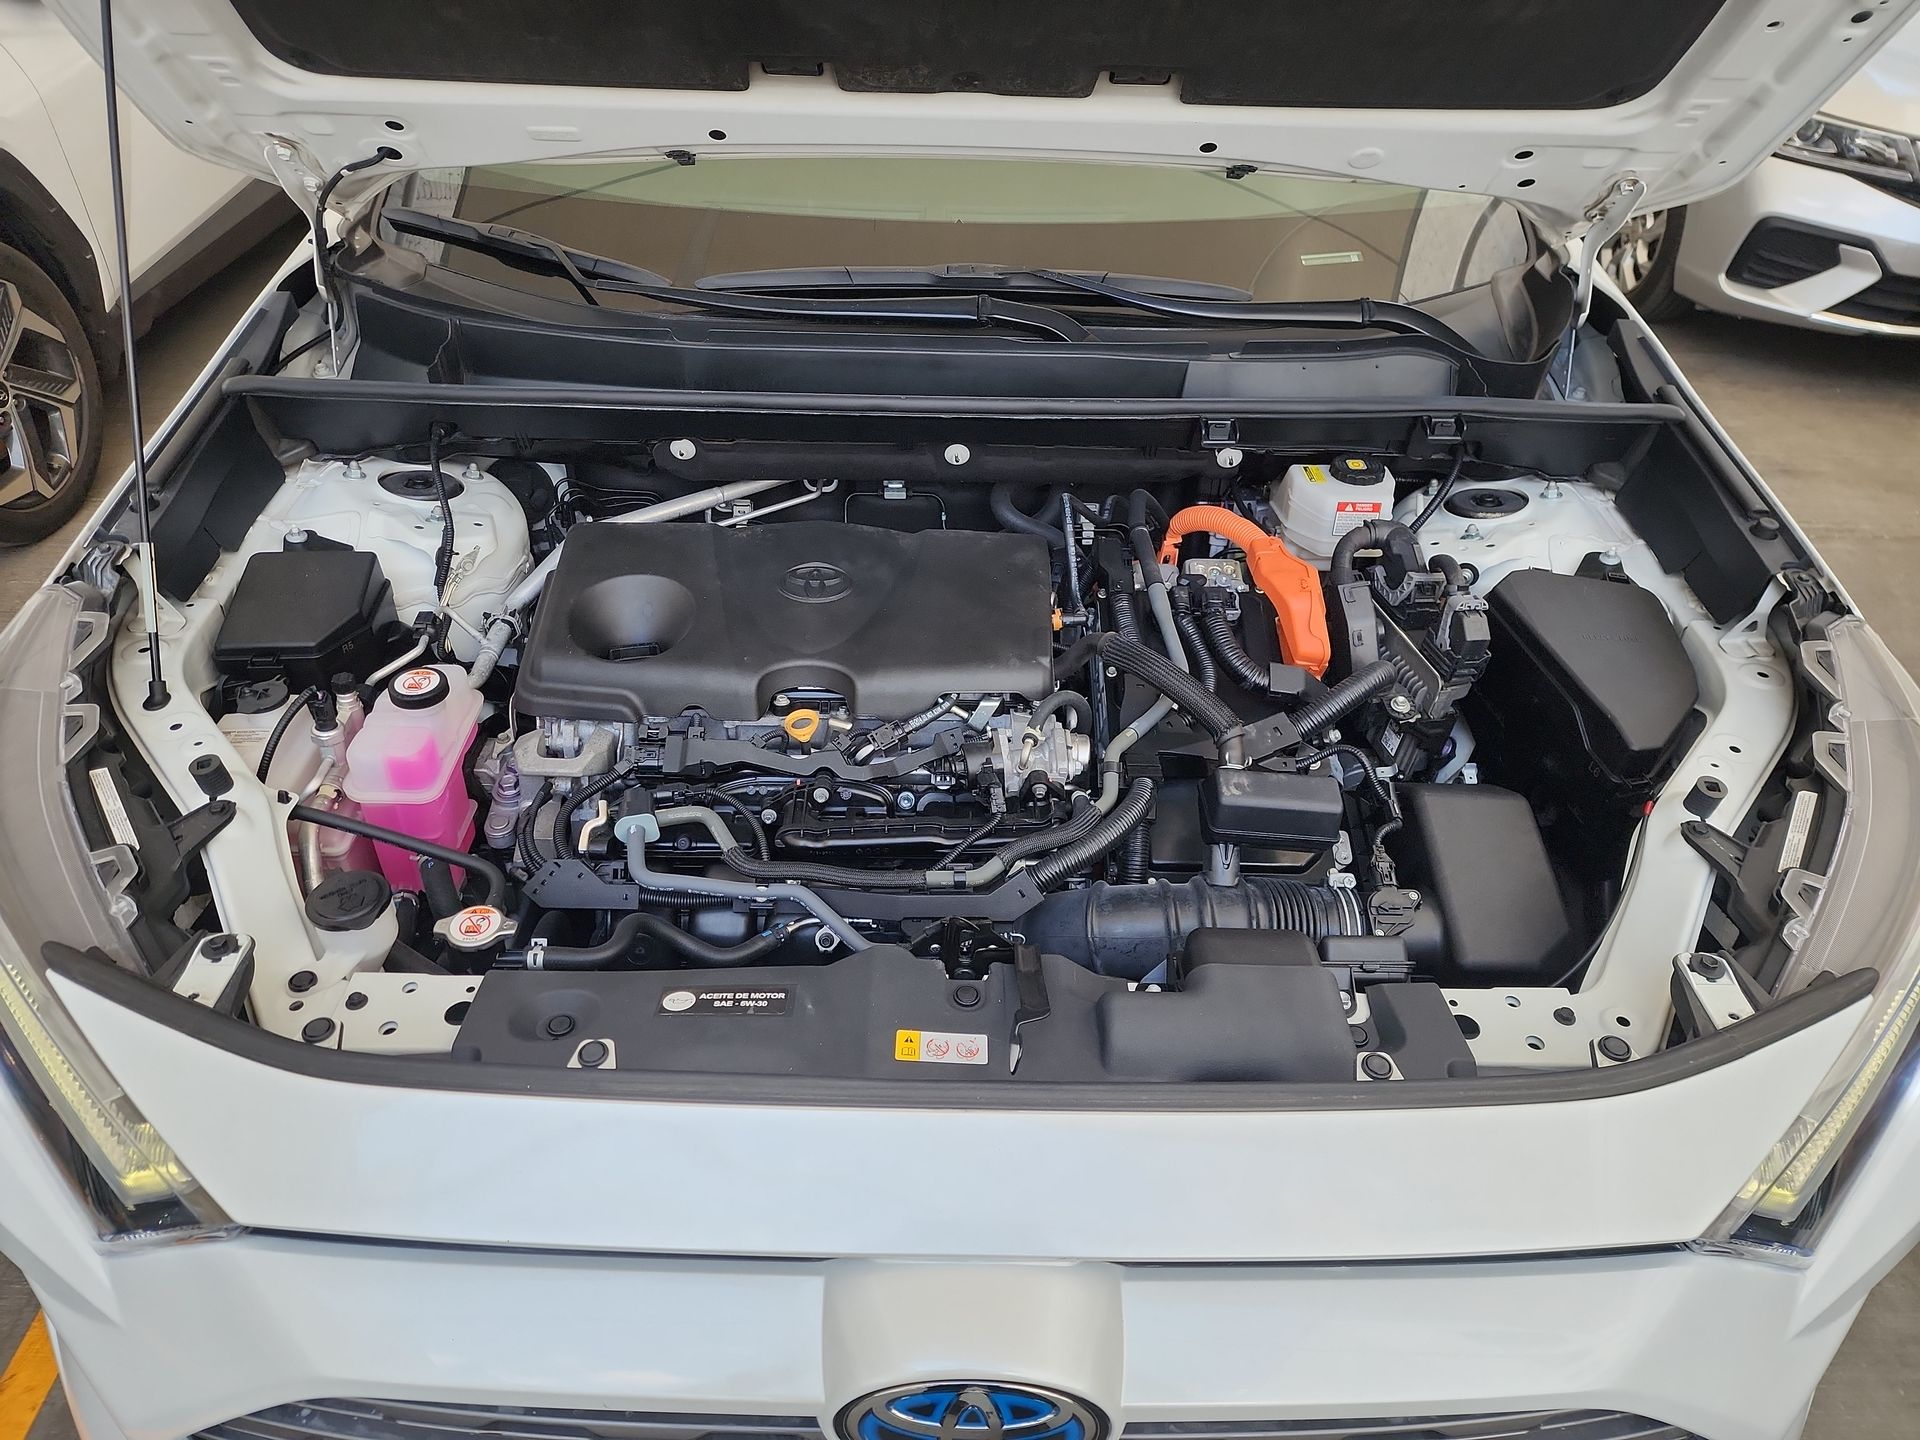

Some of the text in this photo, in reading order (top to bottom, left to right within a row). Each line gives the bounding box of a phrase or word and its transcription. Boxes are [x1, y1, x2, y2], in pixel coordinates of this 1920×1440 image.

[699, 992, 786, 1000] ACEITE DE MOTOR
